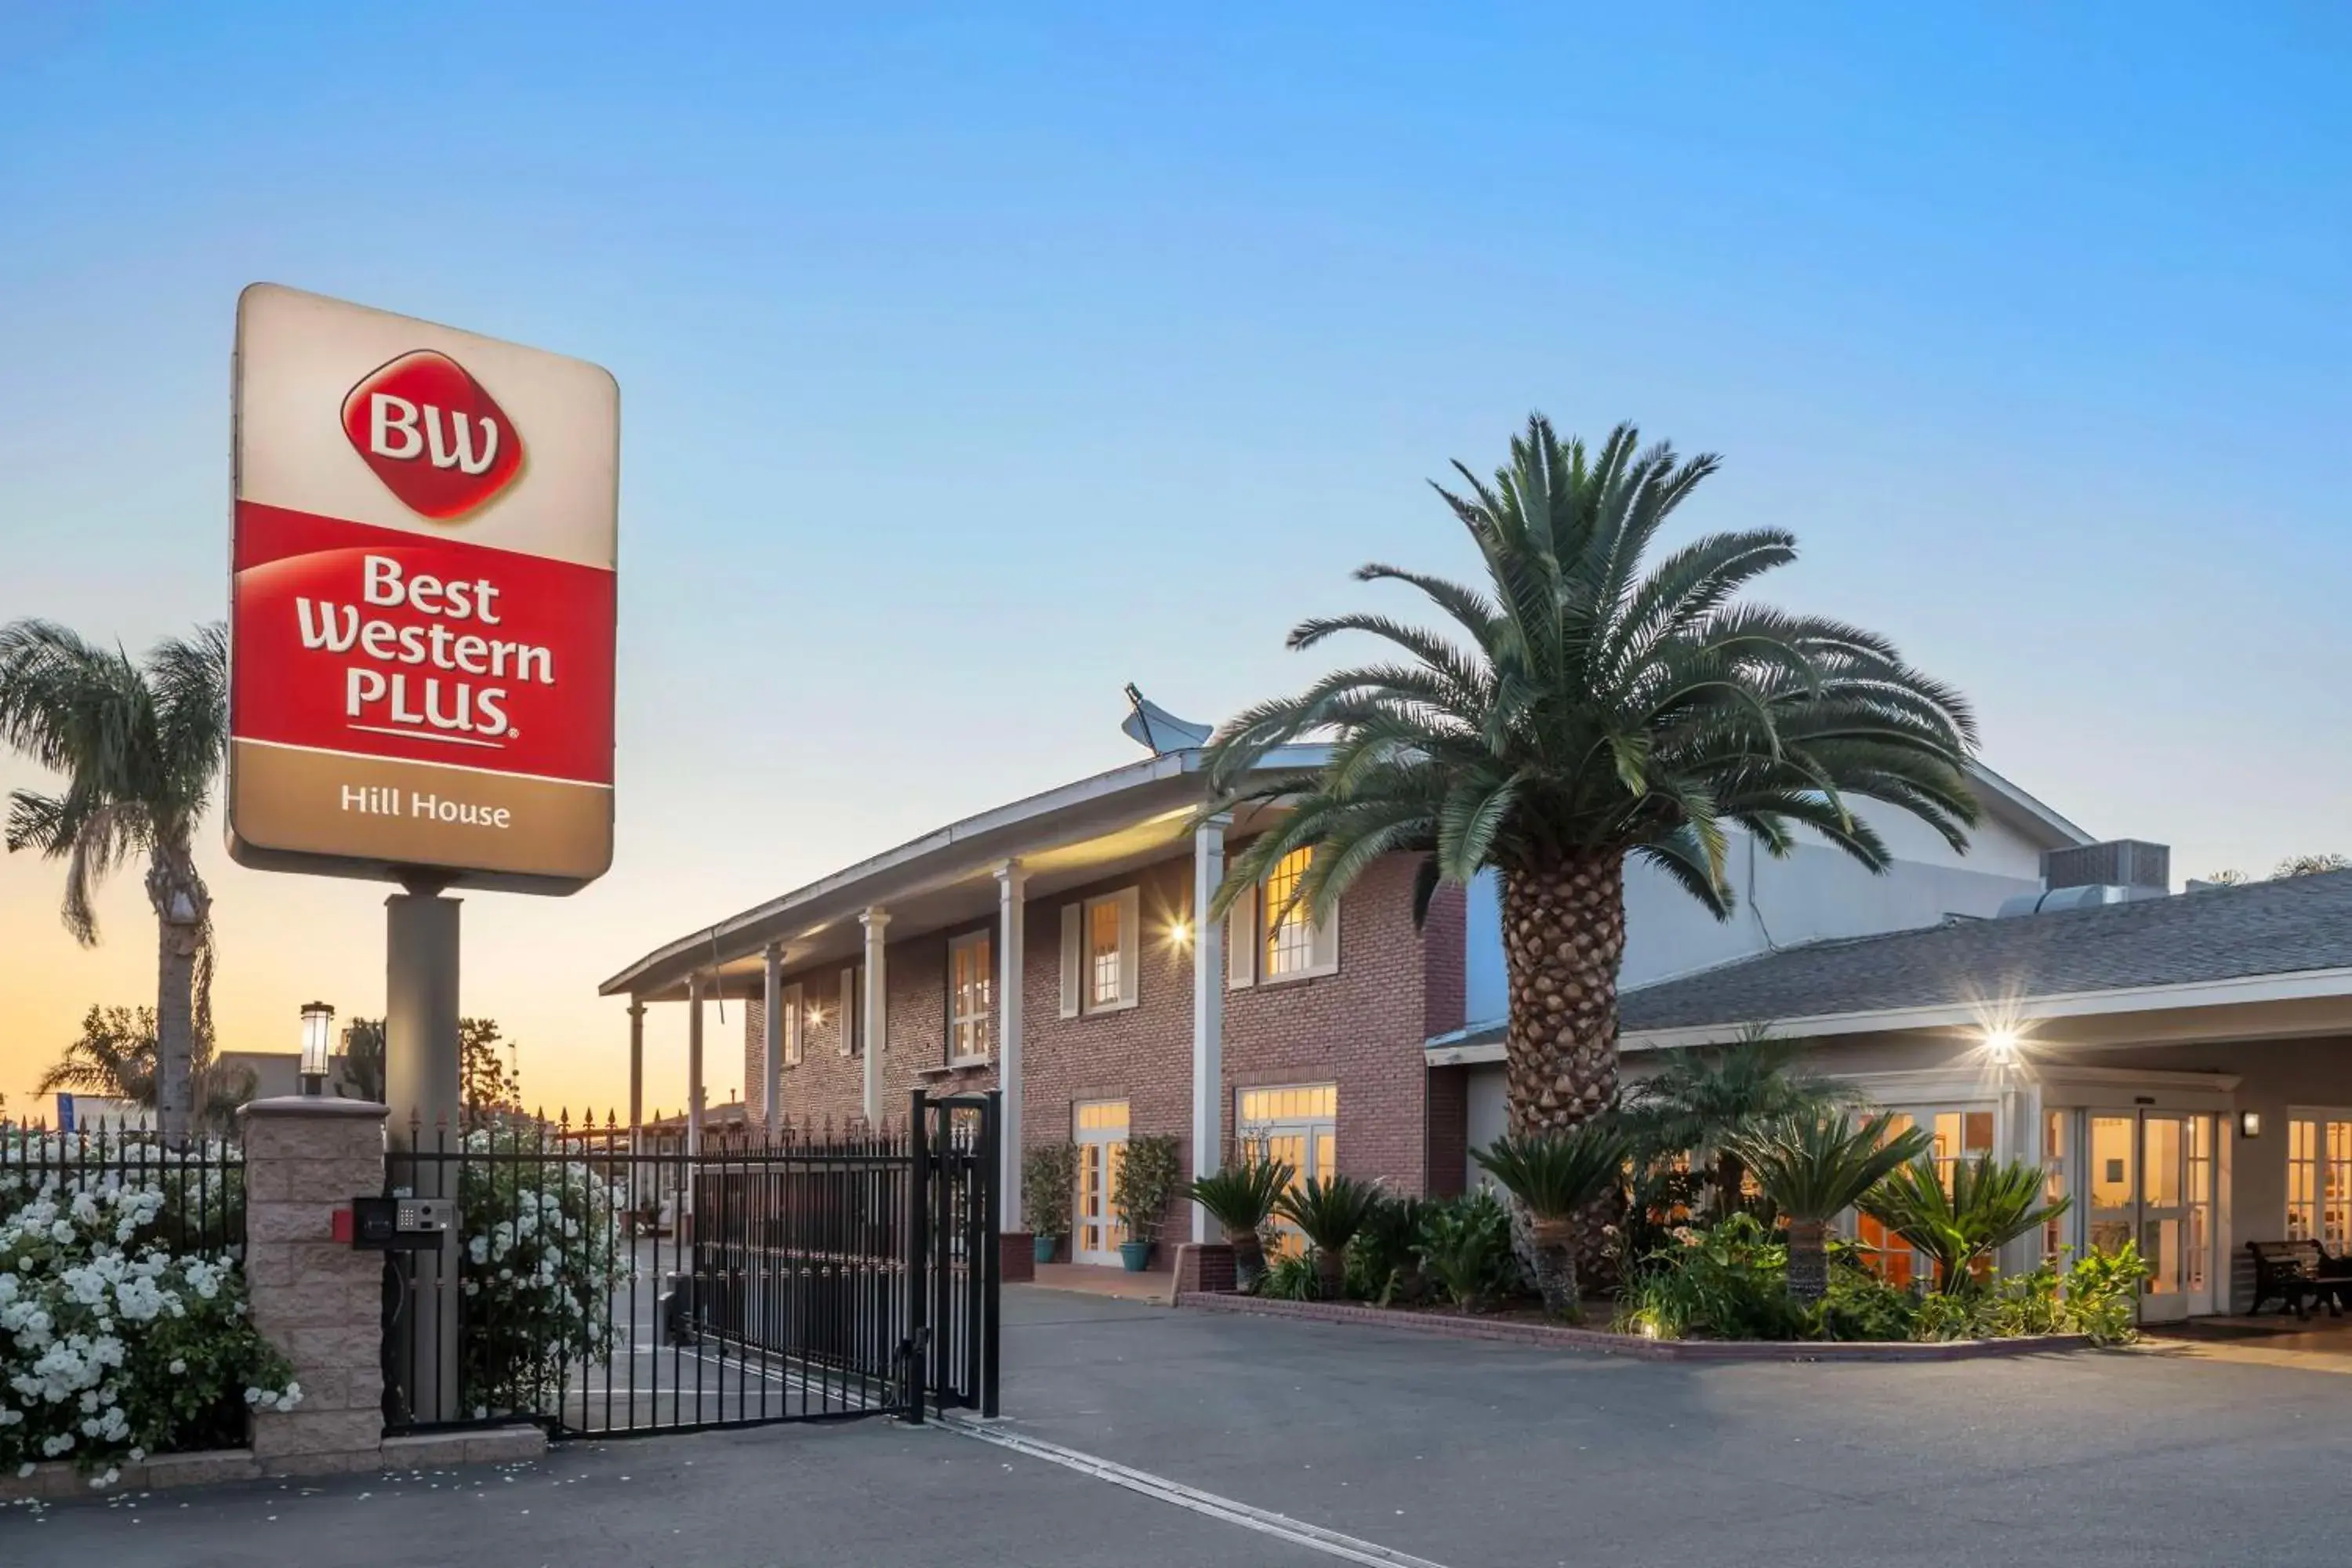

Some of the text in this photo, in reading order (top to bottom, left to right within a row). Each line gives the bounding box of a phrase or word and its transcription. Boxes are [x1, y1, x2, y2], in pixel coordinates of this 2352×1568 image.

[371, 392, 498, 474] BW
[363, 554, 501, 625] Best
[296, 597, 555, 684] Western
[341, 784, 511, 829] Hill House
